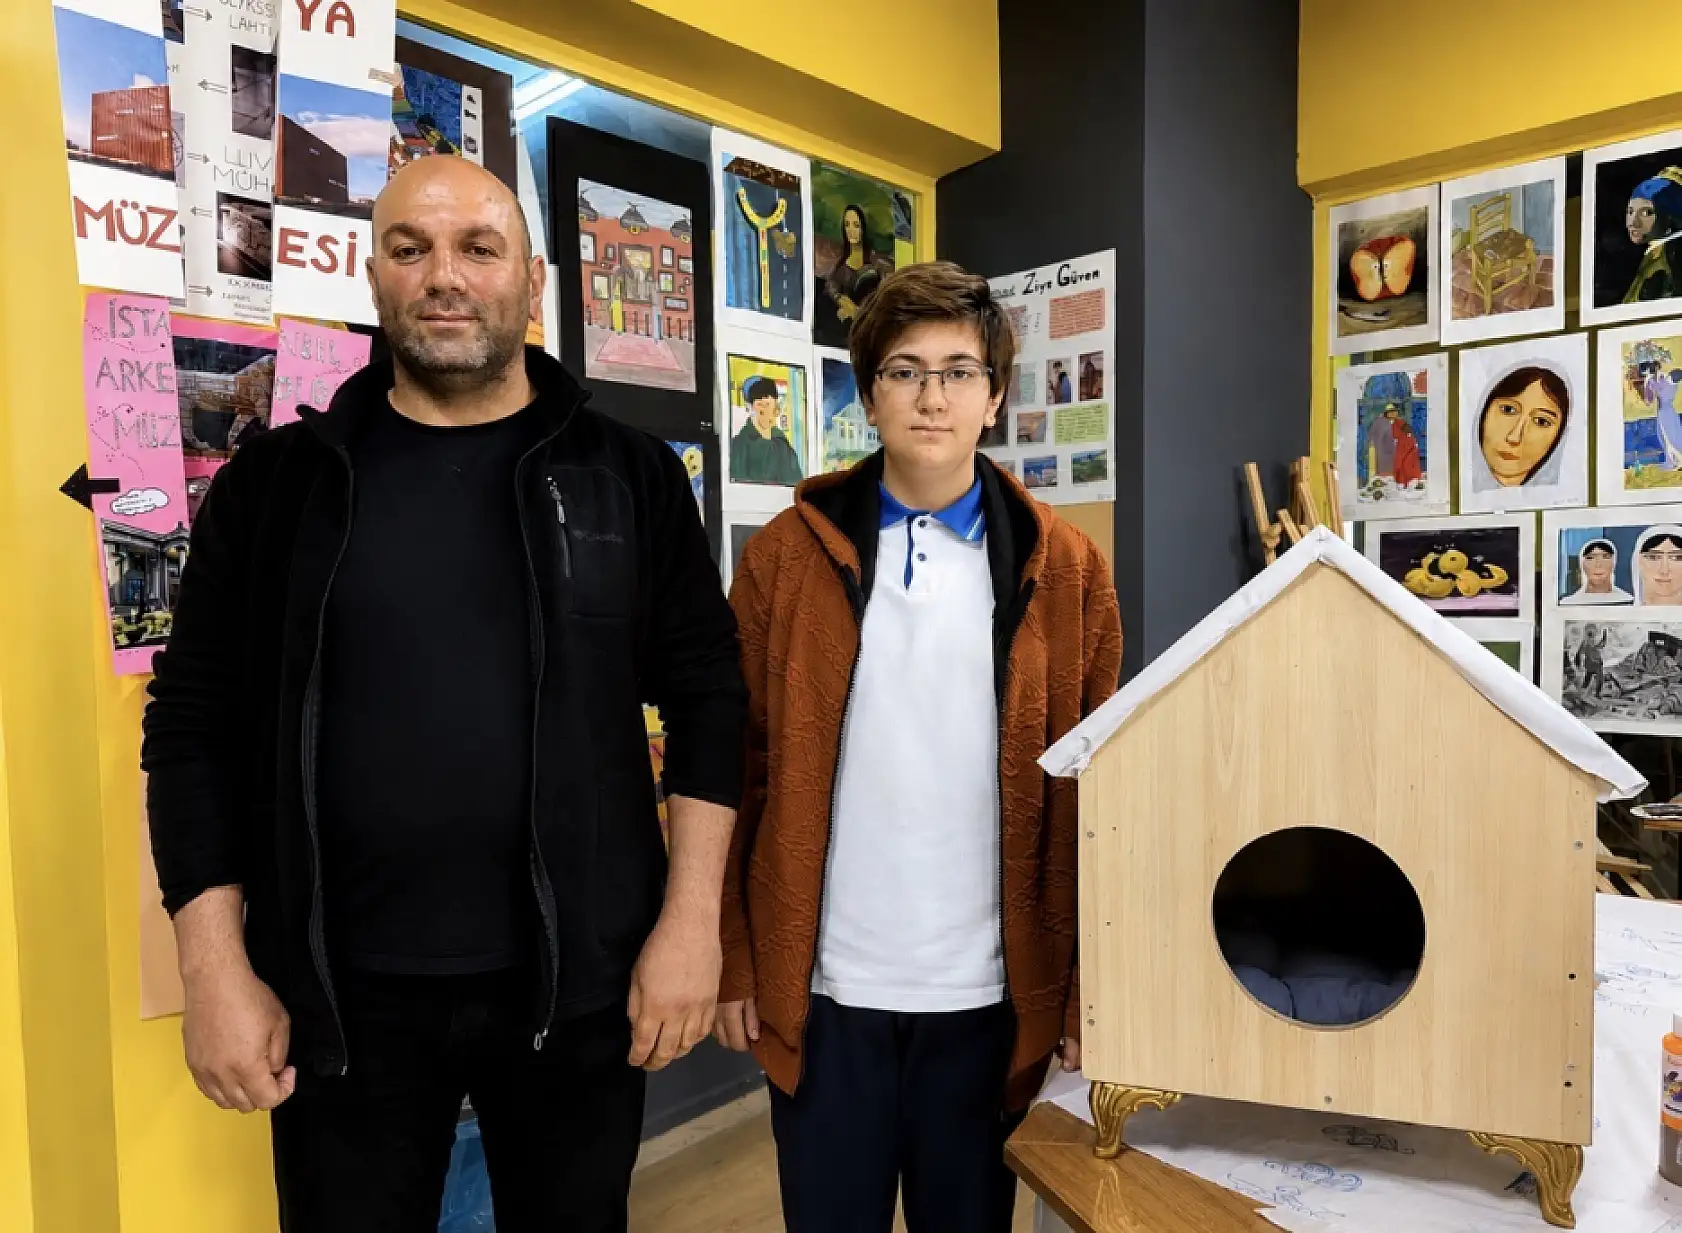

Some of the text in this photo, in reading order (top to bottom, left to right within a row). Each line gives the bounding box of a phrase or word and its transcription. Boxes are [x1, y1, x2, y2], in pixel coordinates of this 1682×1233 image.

[295, 0, 355, 38] YA
[73, 196, 181, 253] MÜZ
[277, 226, 358, 278] ESİ
[95, 356, 175, 394] ARKE
